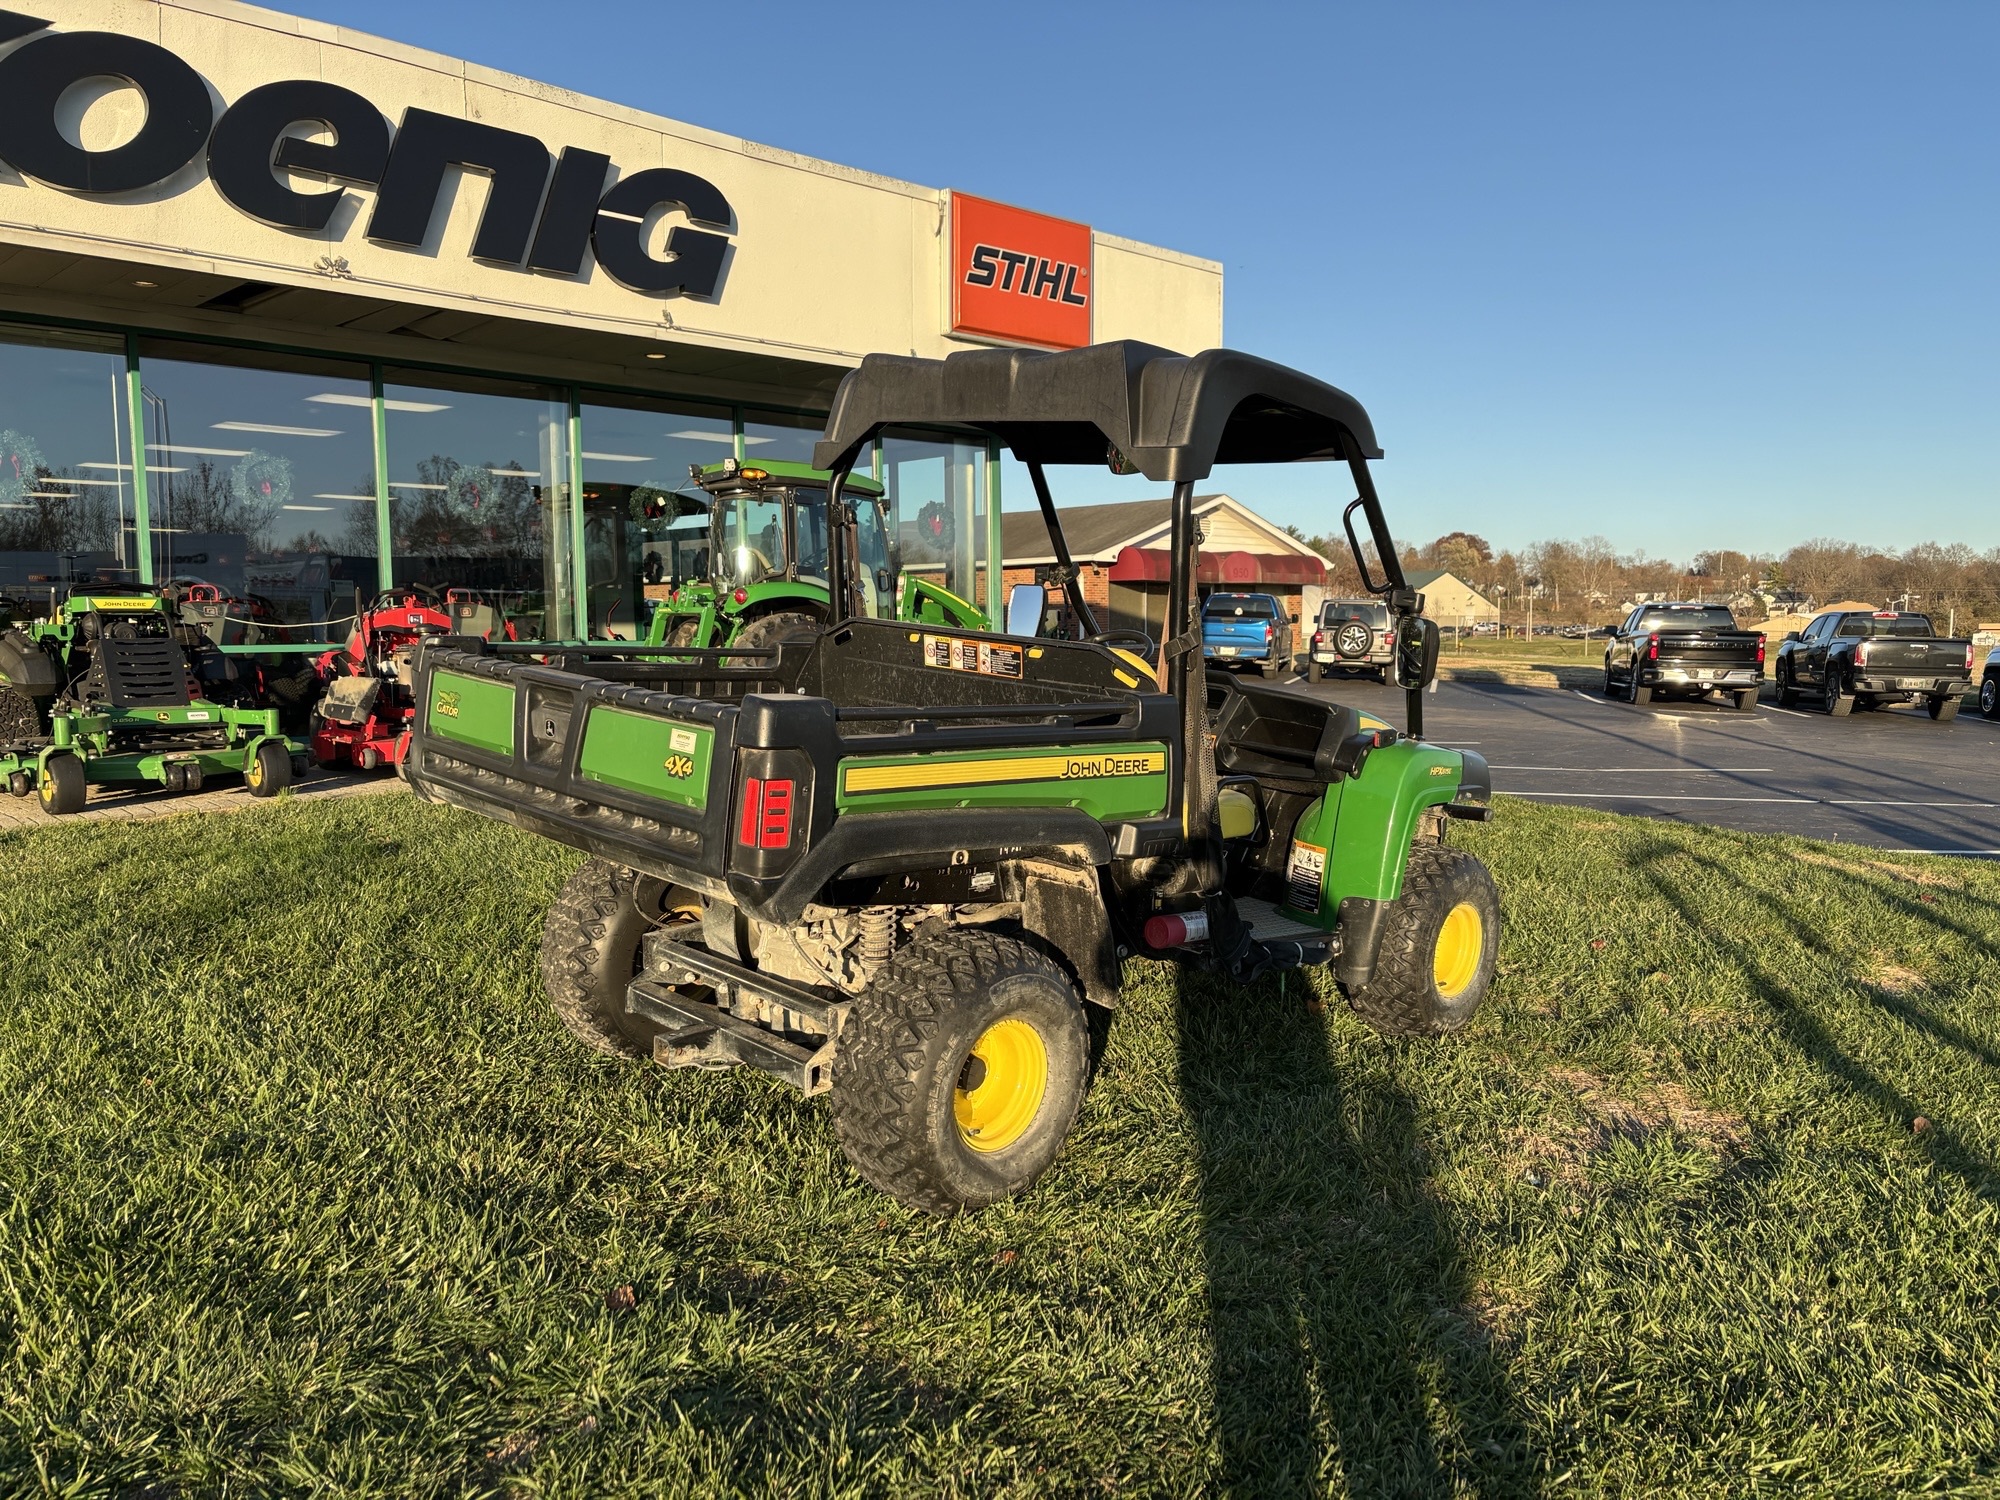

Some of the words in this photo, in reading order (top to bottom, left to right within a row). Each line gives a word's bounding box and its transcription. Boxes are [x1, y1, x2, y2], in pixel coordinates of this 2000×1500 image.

[0, 9, 731, 299] oenig
[965, 243, 1087, 308] STIHL
[1233, 567, 1249, 579] 950
[436, 701, 459, 719] GATOR
[664, 754, 693, 780] 4X4
[1061, 759, 1101, 779] JOHN
[1104, 757, 1150, 775] DEERE
[926, 1033, 961, 1143] CARLISLE
